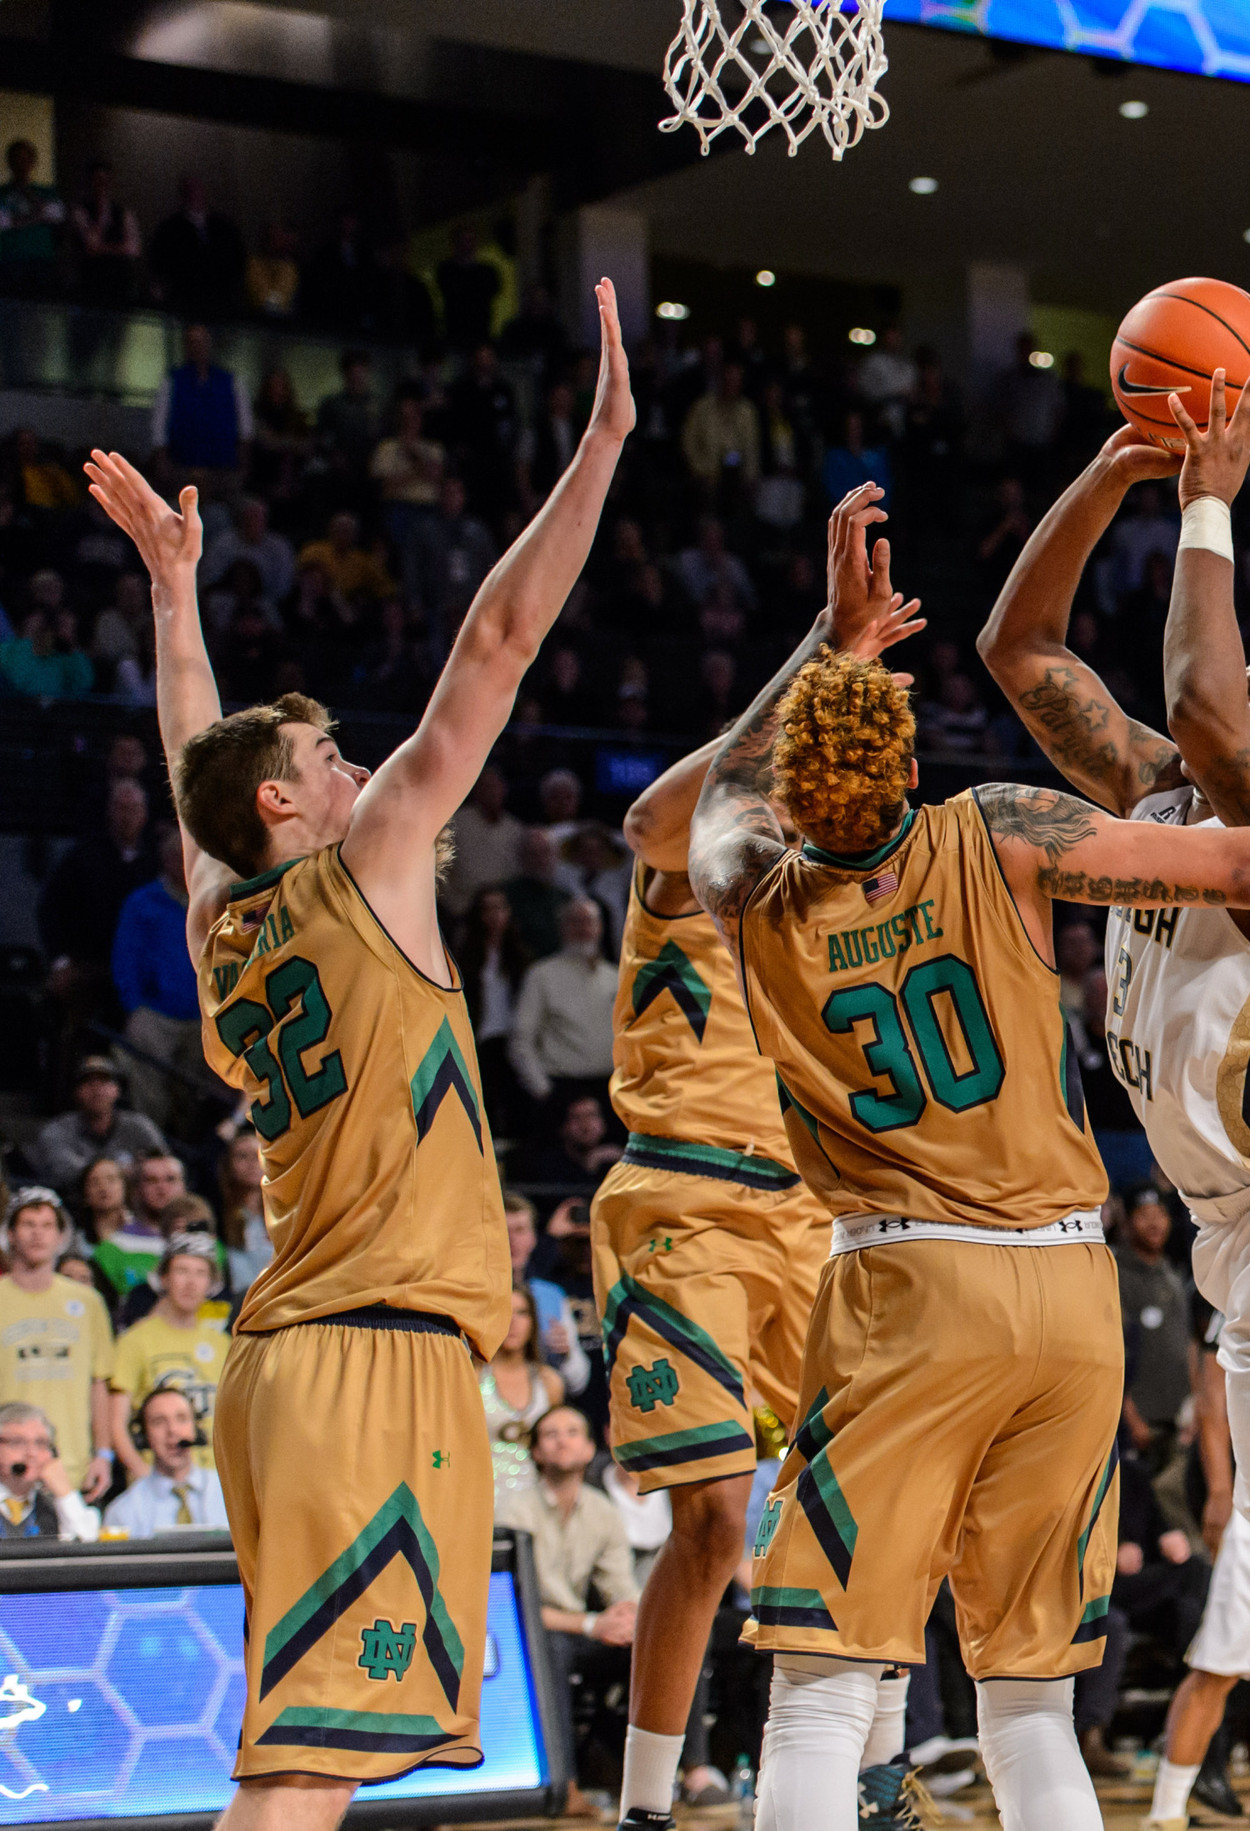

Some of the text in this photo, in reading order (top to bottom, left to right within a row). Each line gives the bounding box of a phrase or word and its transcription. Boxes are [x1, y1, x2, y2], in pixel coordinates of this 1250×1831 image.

[828, 899, 944, 973] AUGUSTE
[1112, 944, 1133, 1020] 3
[215, 955, 349, 1143] 32
[820, 953, 1006, 1134] 30
[1106, 1030, 1153, 1103] ECH
